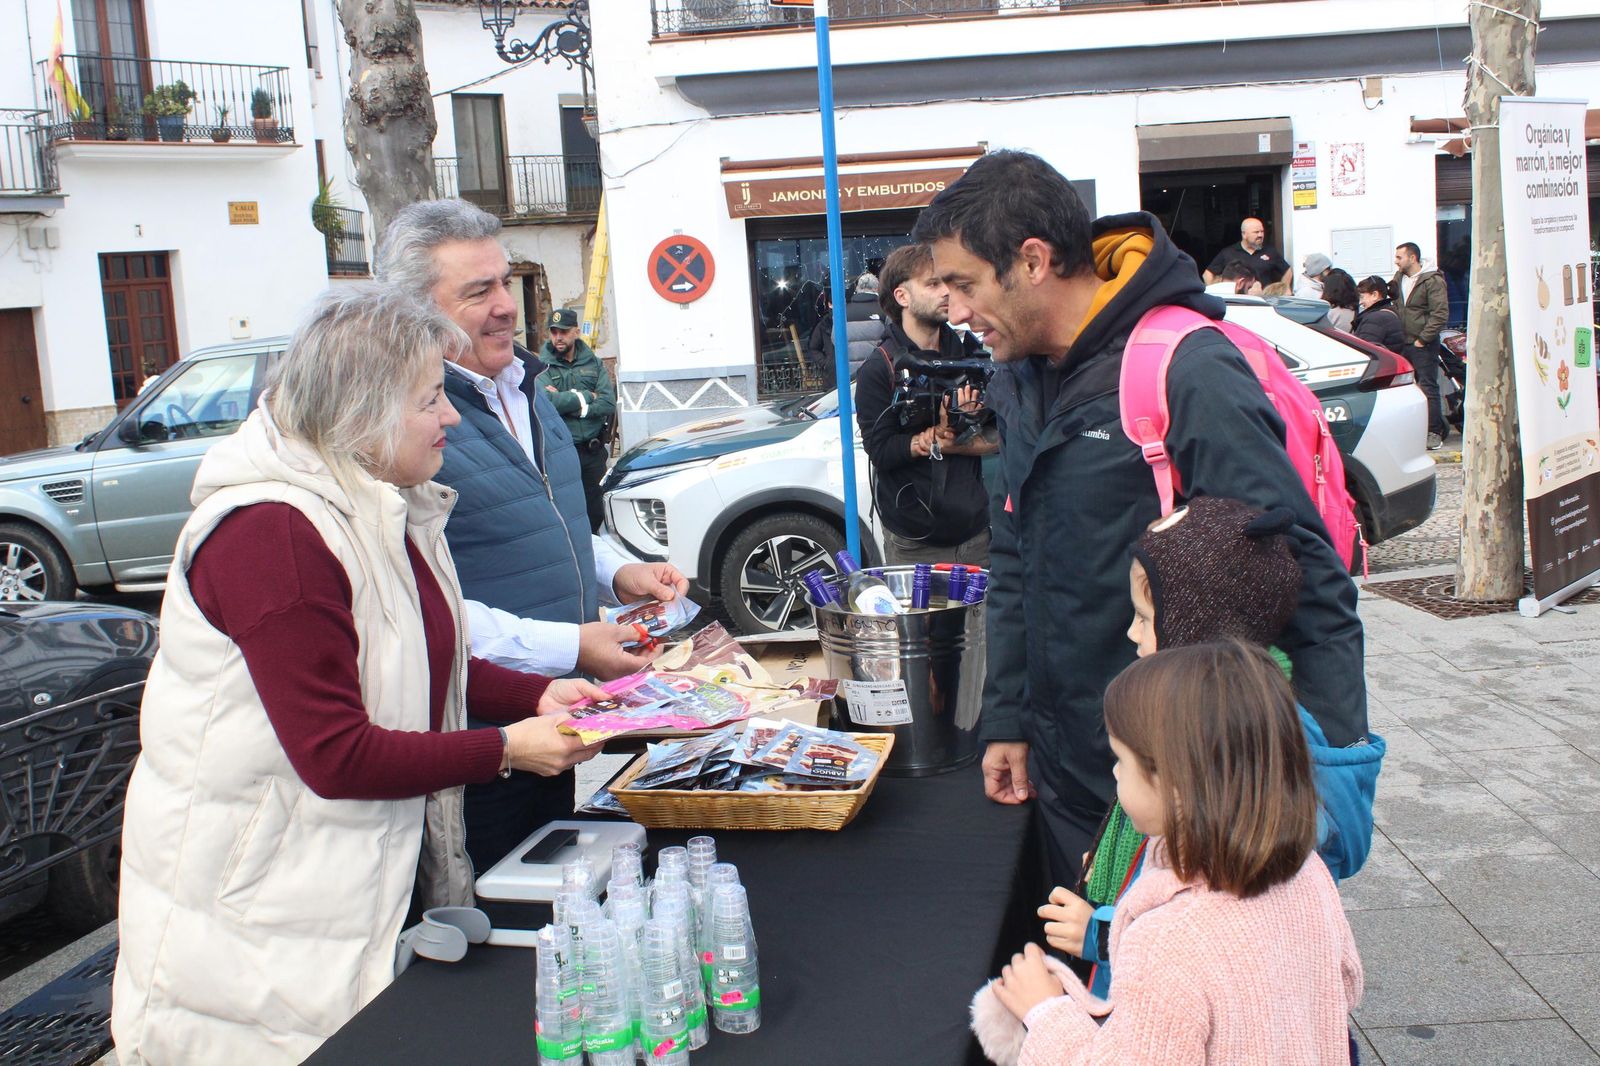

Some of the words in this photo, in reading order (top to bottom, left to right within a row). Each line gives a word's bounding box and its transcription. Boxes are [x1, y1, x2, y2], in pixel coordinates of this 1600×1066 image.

[1525, 123, 1563, 148] Orgánica
[1564, 128, 1570, 147] y
[1516, 151, 1548, 173] marrón,
[1548, 151, 1555, 171] la
[1555, 151, 1583, 174] mejor
[844, 187, 856, 198] Y
[857, 181, 946, 197] EMBUTIDOS
[1526, 177, 1579, 199] combinación
[1324, 406, 1348, 422] 62
